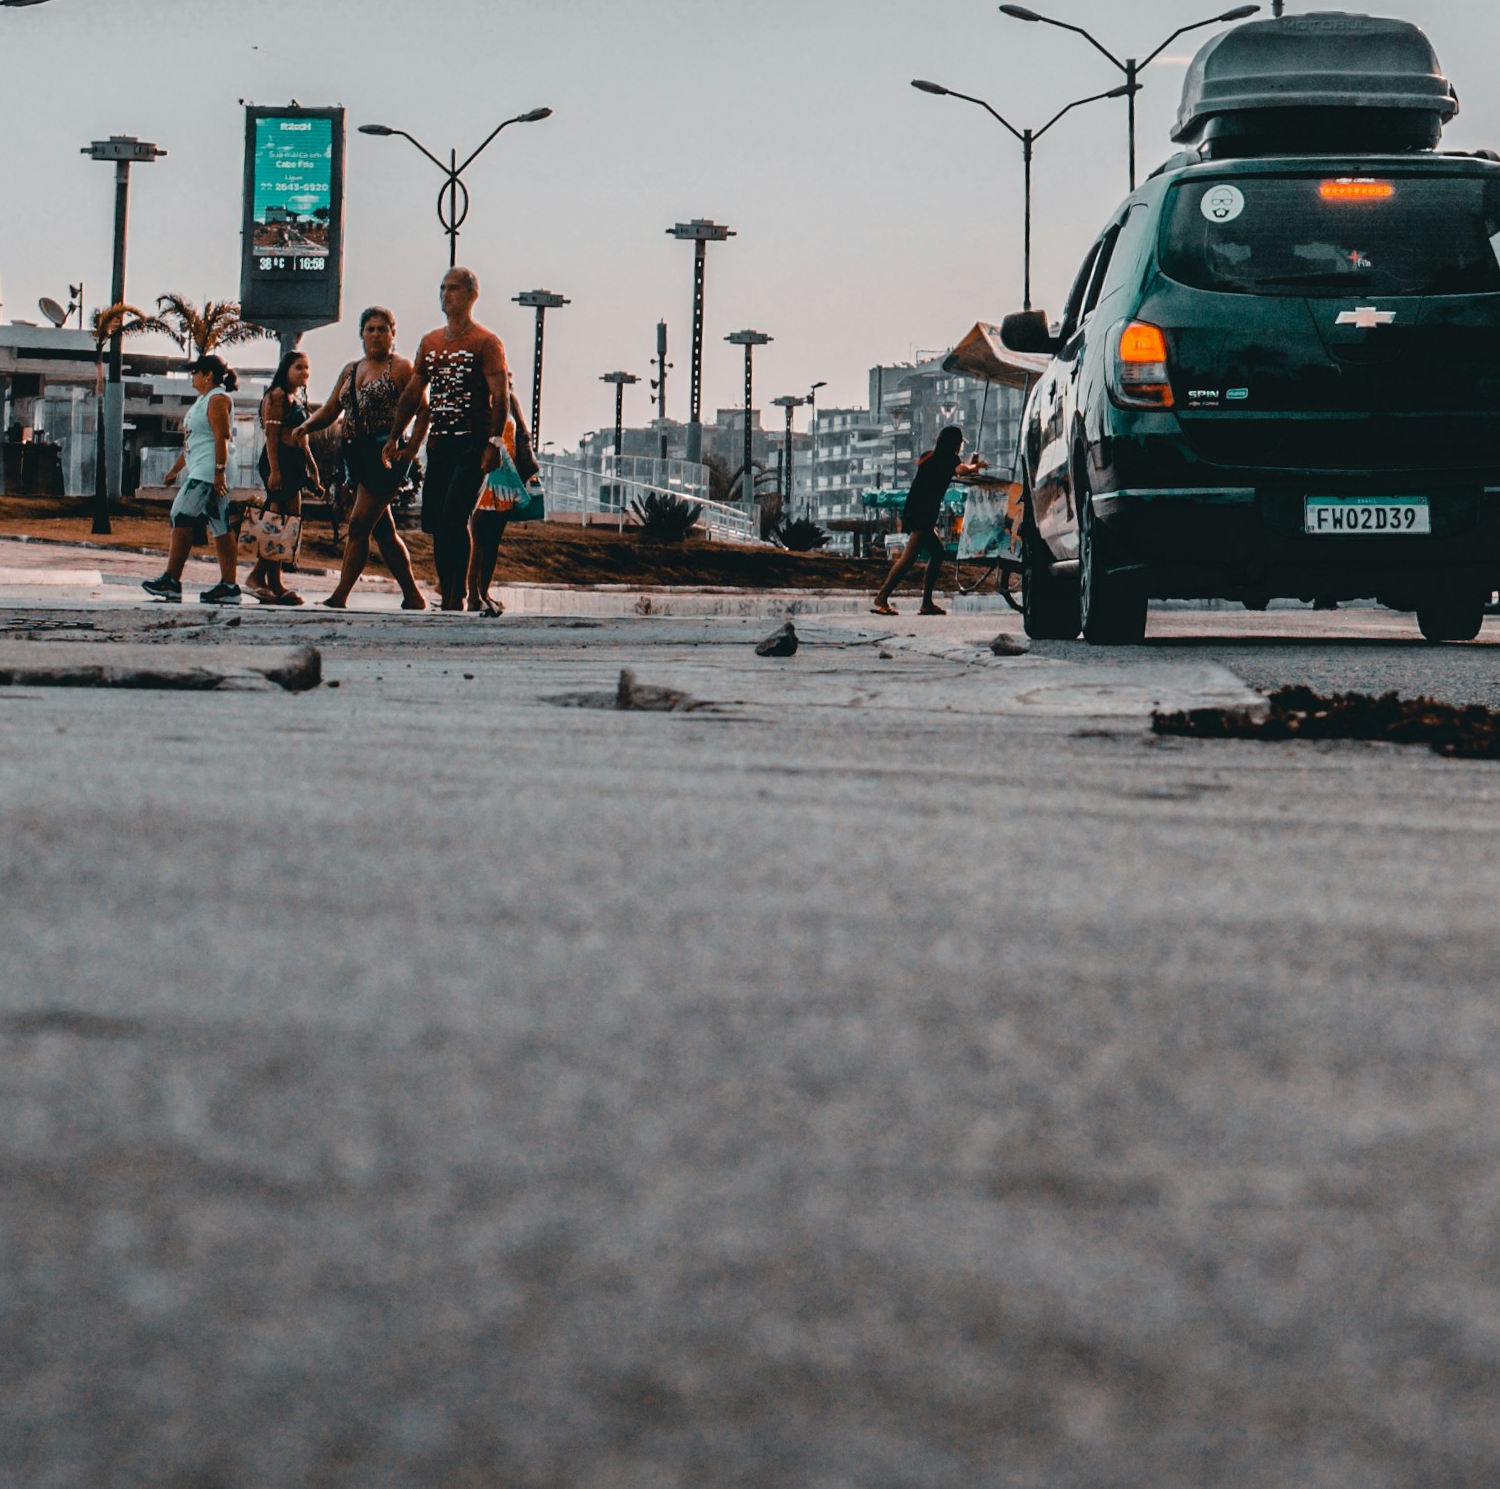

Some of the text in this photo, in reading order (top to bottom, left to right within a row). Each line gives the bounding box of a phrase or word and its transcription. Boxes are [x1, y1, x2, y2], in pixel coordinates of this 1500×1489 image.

[276, 160, 314, 168] Cabo Frio
[1188, 390, 1219, 398] SPIN
